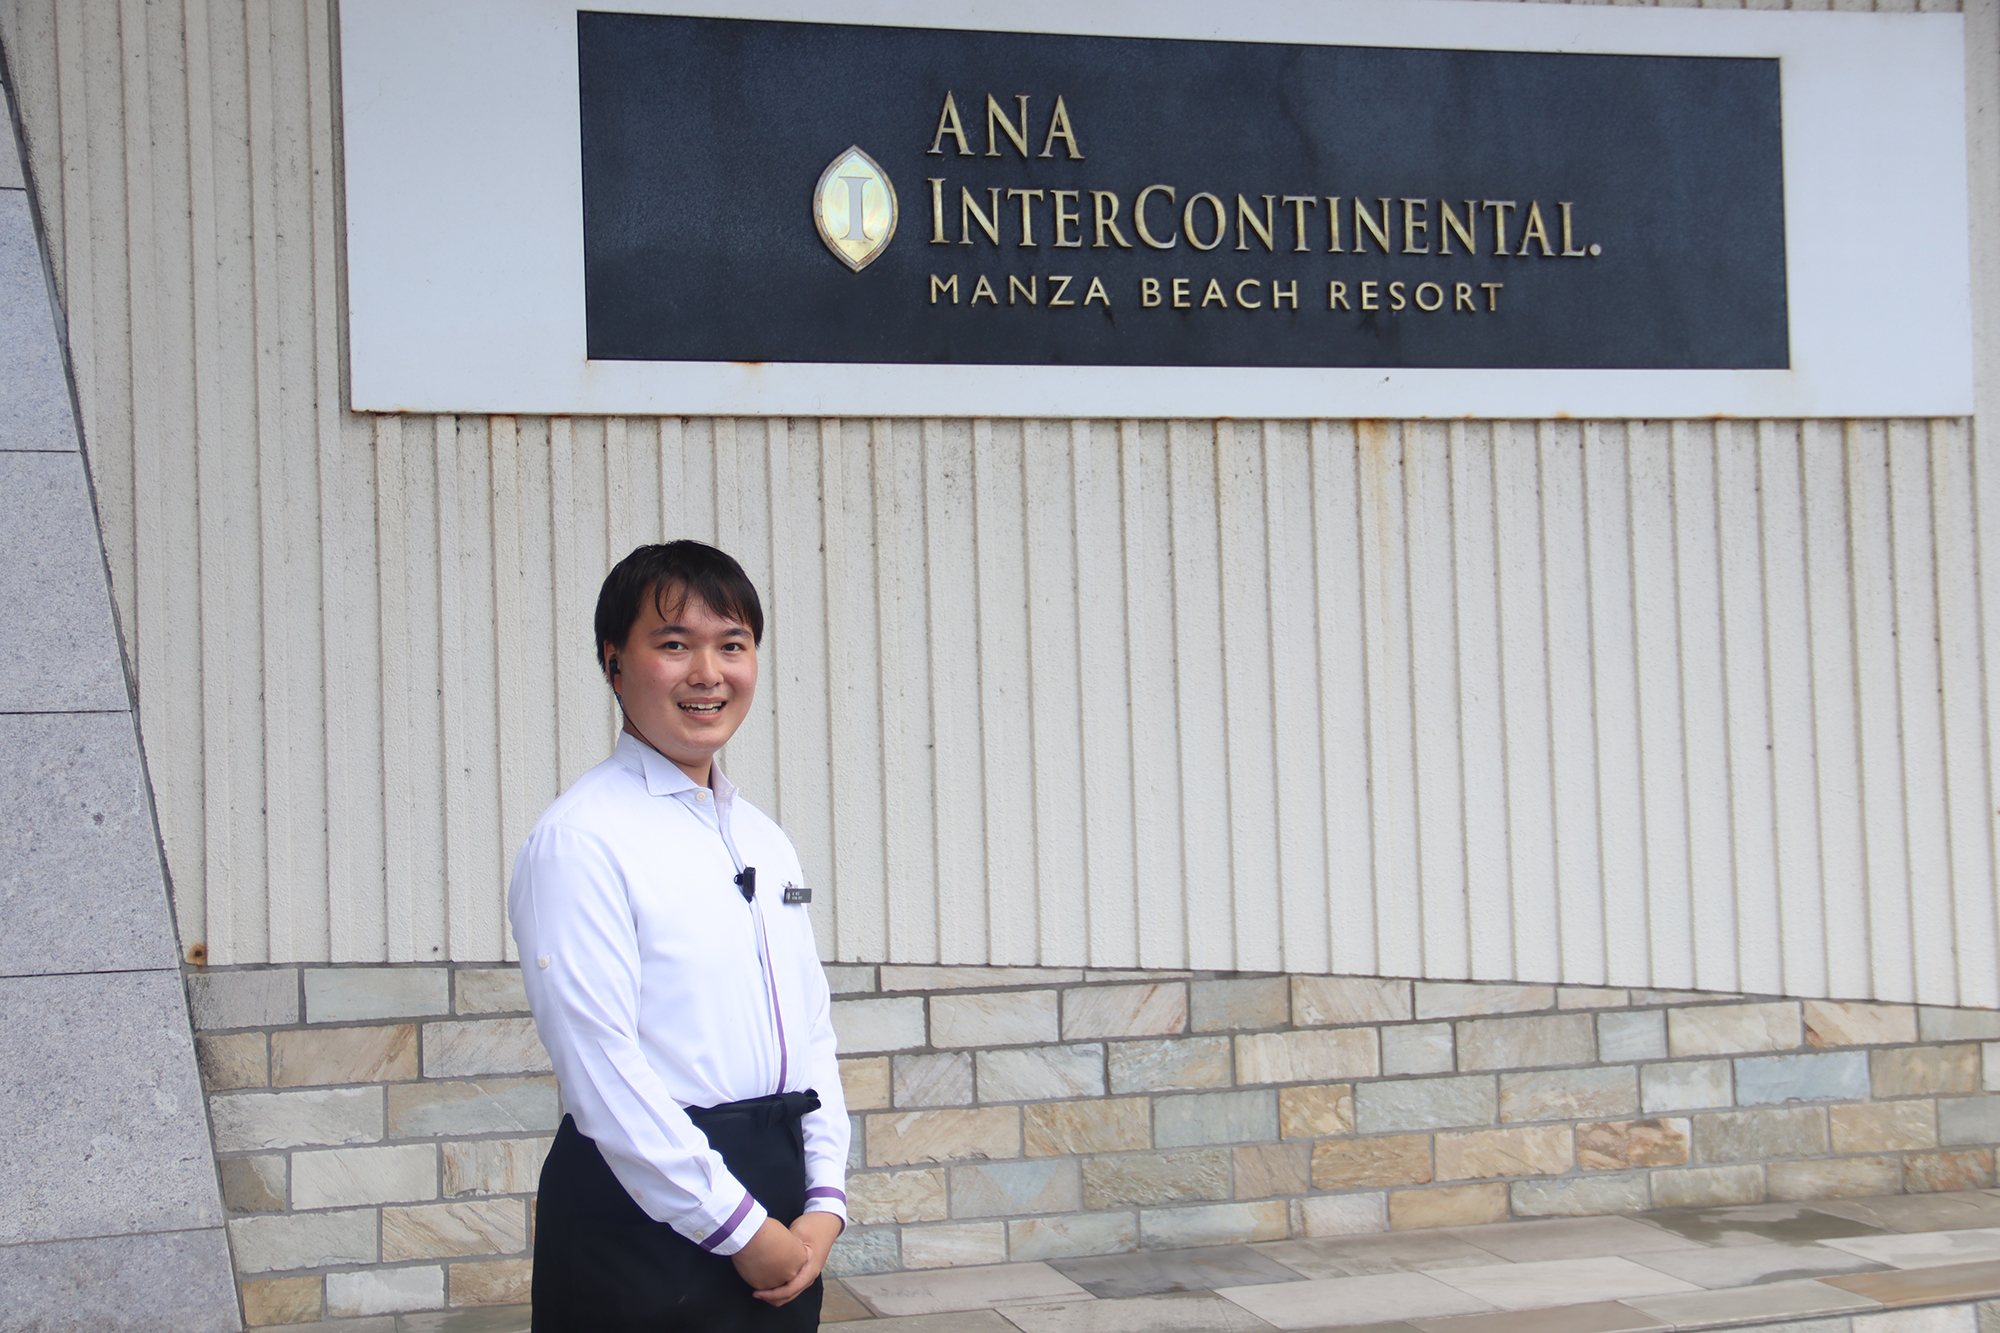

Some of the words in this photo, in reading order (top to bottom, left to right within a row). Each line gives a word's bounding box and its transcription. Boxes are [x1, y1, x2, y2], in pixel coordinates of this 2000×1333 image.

[926, 90, 1086, 160] ANA
[929, 273, 1112, 308] MANZA
[1141, 277, 1300, 311] BEACH
[1329, 281, 1505, 314] RESORT
